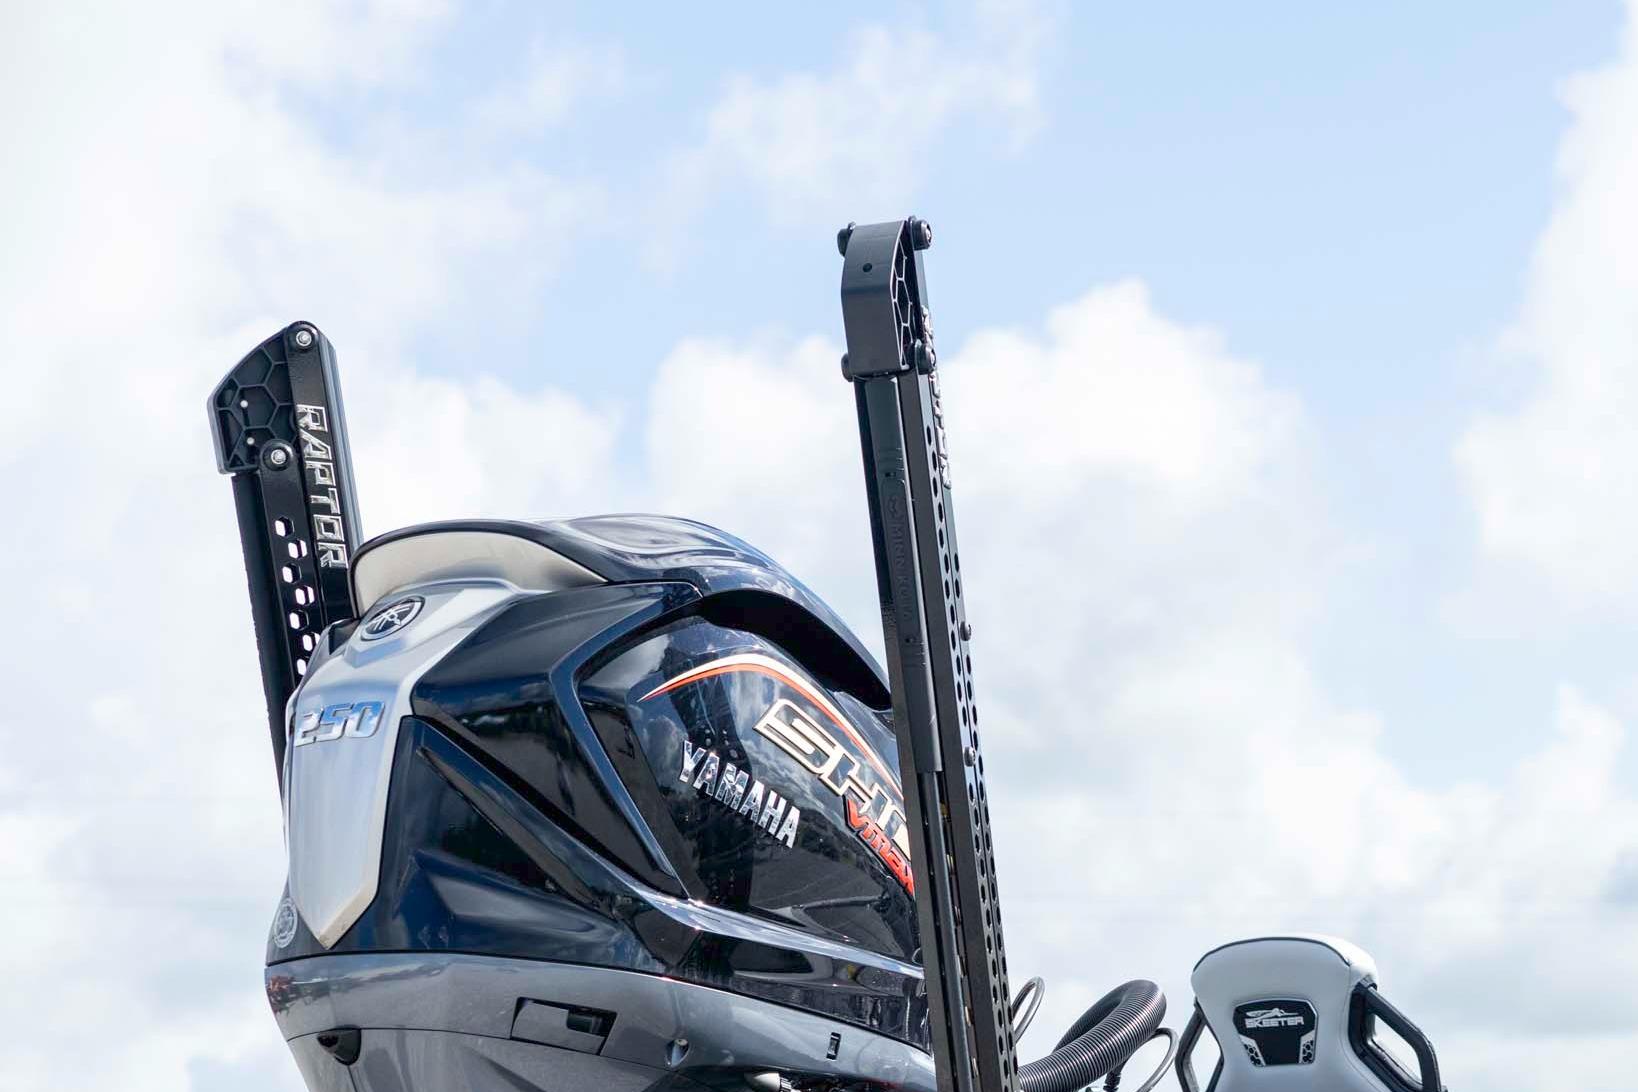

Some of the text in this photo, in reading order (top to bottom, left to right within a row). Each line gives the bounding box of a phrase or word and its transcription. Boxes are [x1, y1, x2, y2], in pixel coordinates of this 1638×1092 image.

[297, 404, 349, 569] RAPTOR
[295, 700, 385, 747] 250
[680, 740, 800, 849] YAMAHA
[1245, 1016, 1304, 1029] SKEETER
